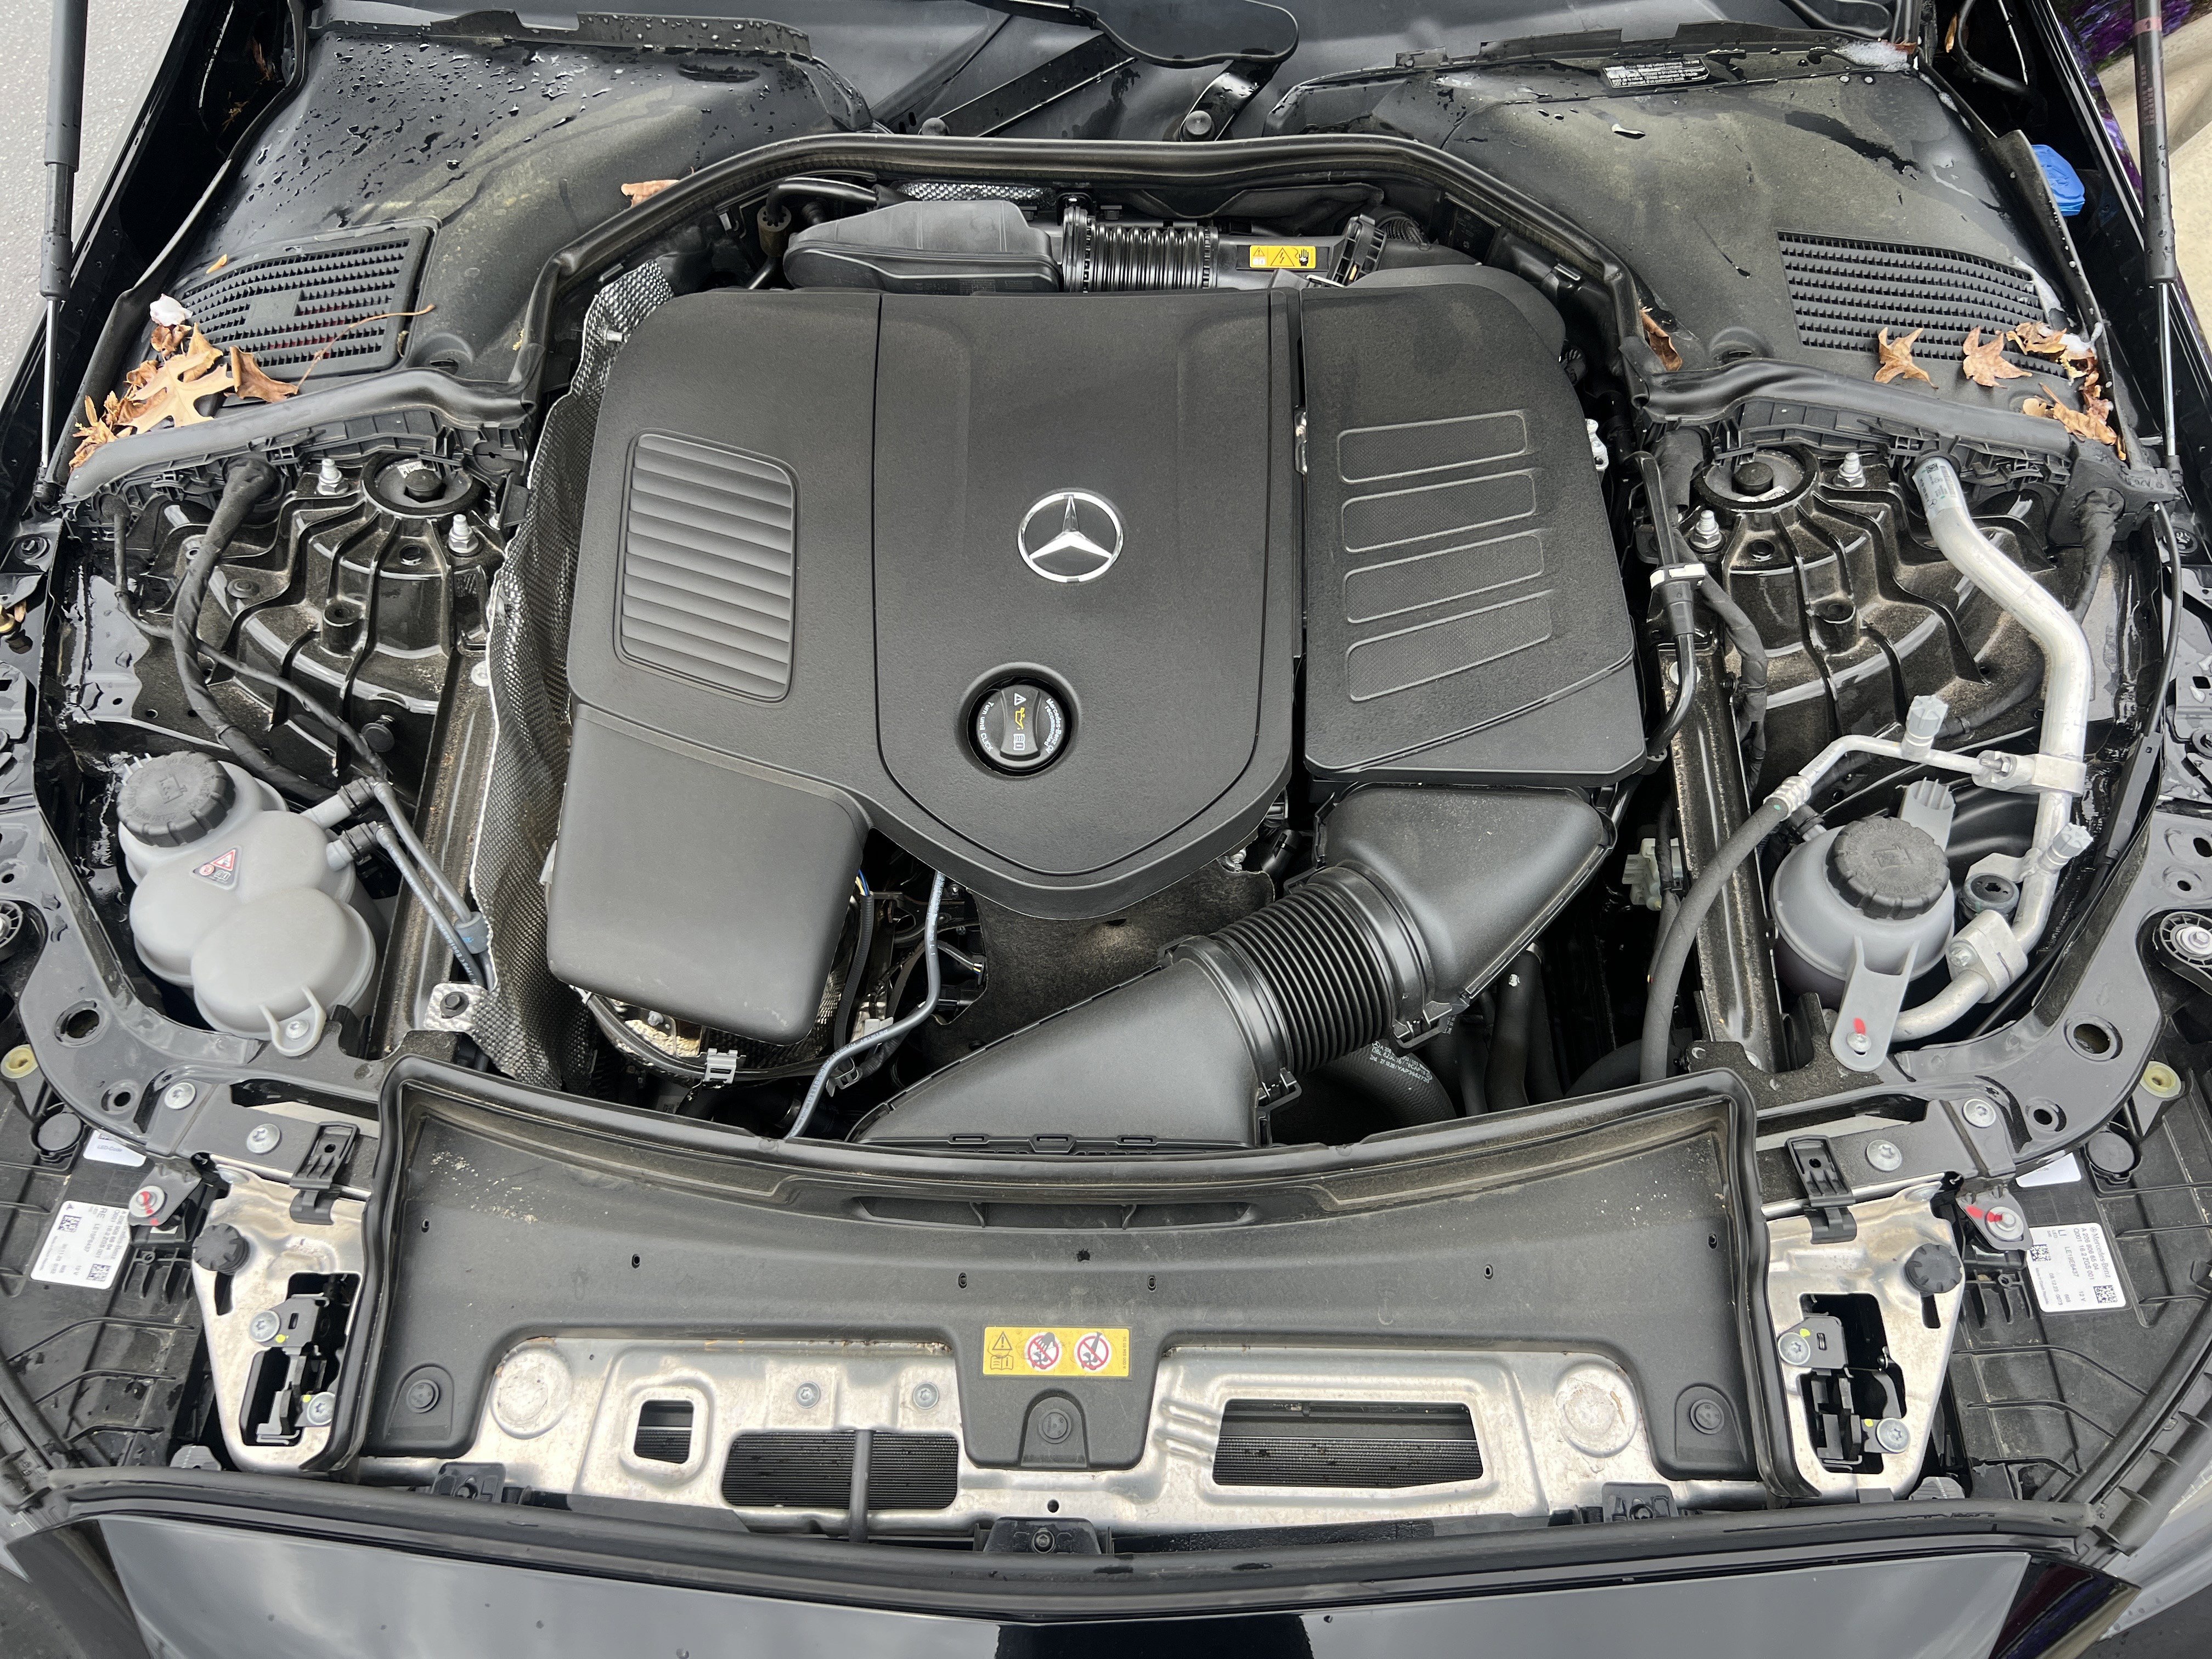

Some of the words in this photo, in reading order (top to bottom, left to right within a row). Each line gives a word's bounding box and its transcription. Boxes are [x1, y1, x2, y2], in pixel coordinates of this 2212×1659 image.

[981, 701, 994, 715] Turn
[980, 732, 994, 752] CLICK
[97, 1207, 108, 1219] RE
[2073, 1228, 2083, 1242] Q001
[2083, 1256, 2092, 1269] ZGS
[2091, 1233, 2111, 1278] Mercedes-Benz
[2086, 1270, 2094, 1280] 001
